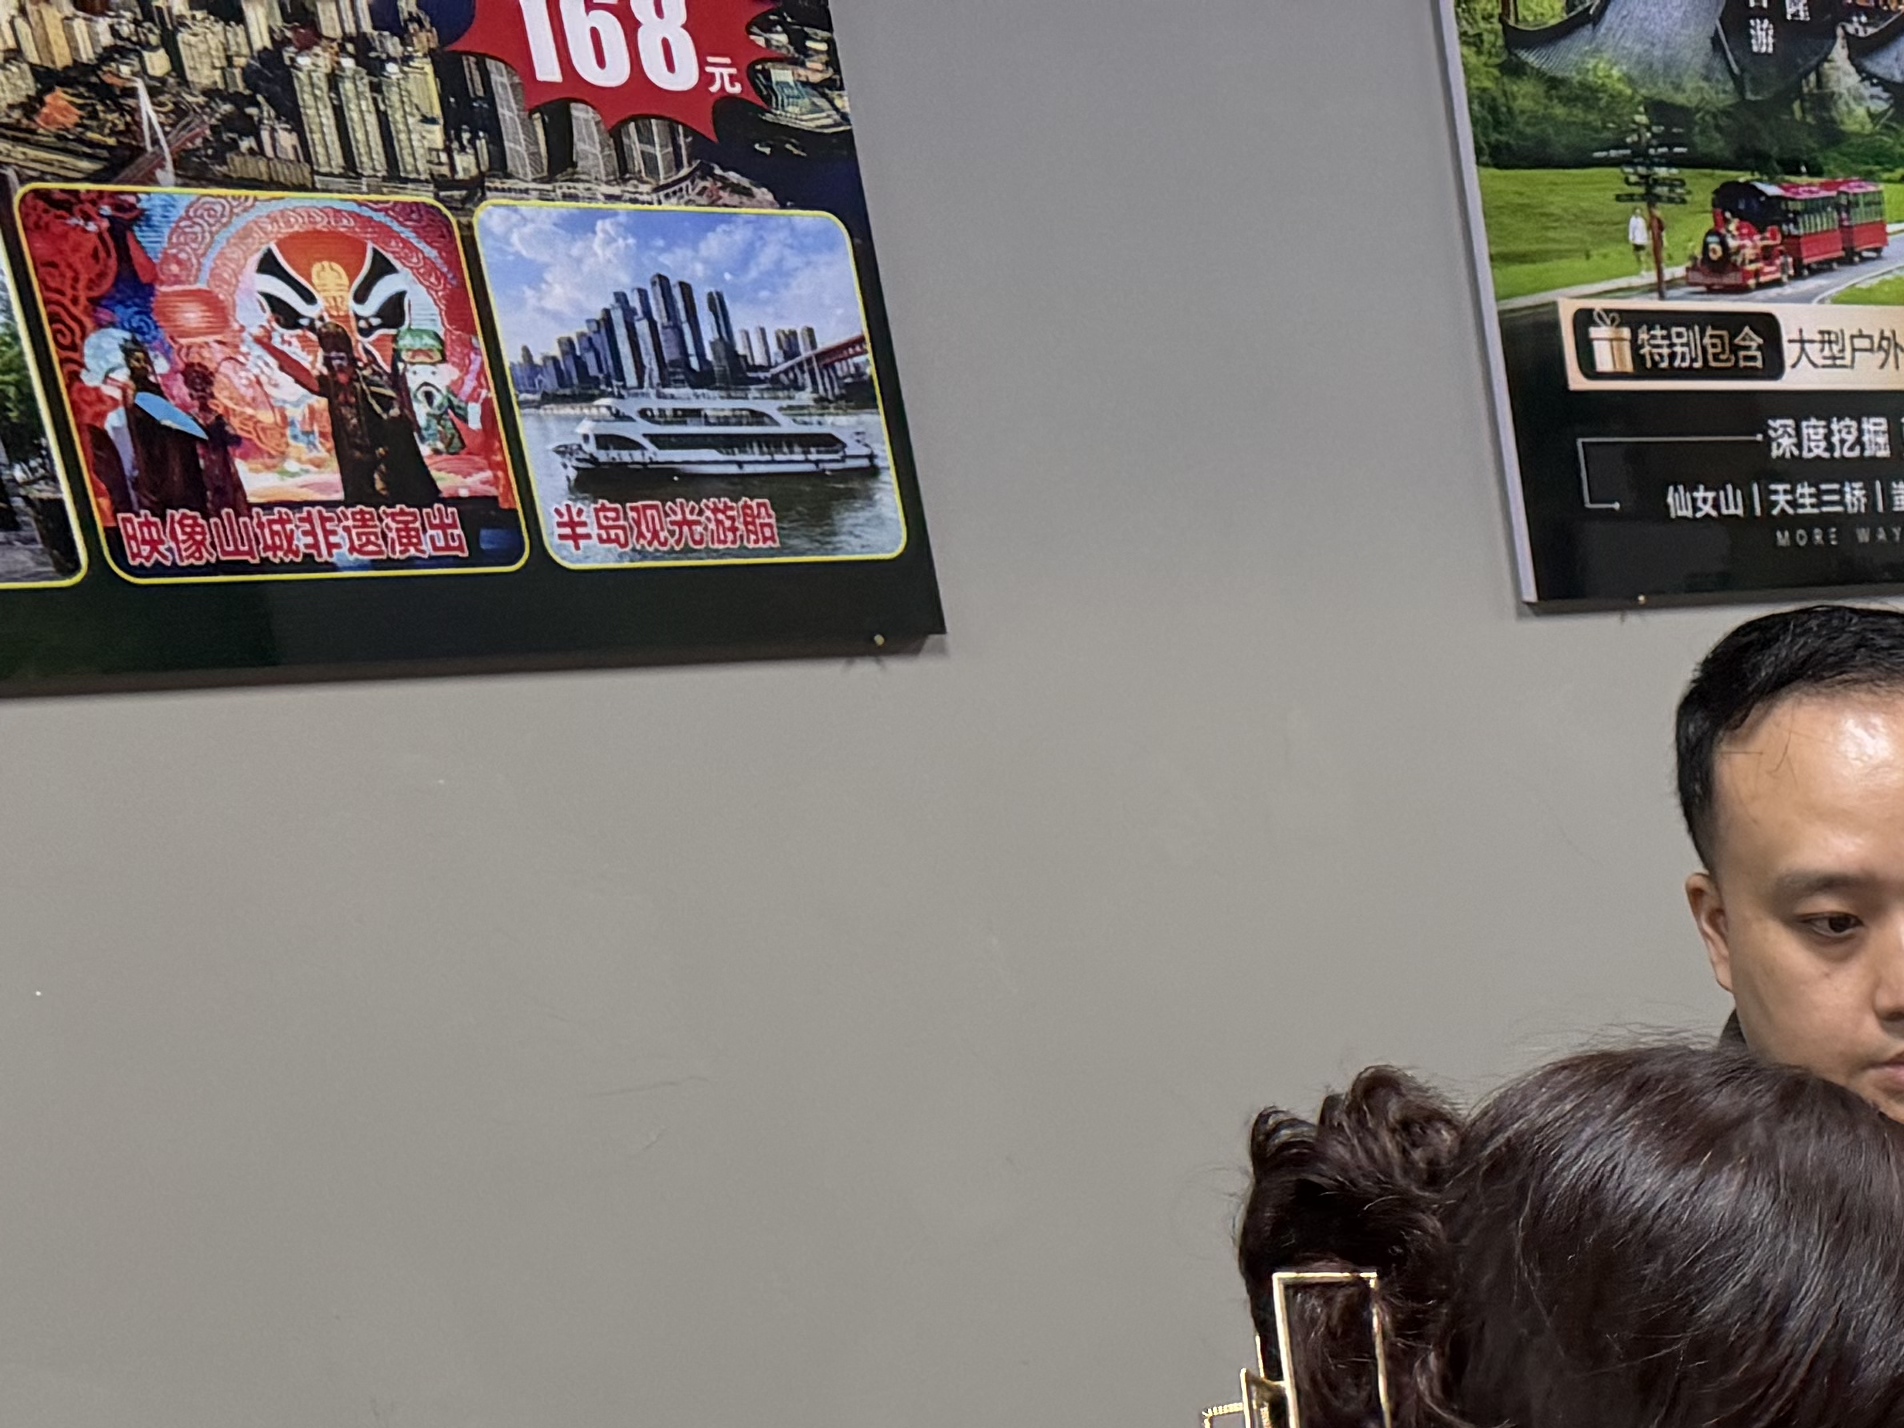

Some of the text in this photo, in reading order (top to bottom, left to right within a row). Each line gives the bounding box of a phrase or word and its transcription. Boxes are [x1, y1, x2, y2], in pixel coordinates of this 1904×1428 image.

[1637, 324, 1764, 369] 特别包含
[1767, 416, 1891, 459] 深度挖掘
[1667, 483, 1744, 518] 仙女山
[1768, 481, 1867, 515] 天生三桥
[117, 503, 469, 566] 映像山城非遗演出
[554, 497, 779, 551] 半岛观光游船
[1776, 527, 1838, 547] MORE
